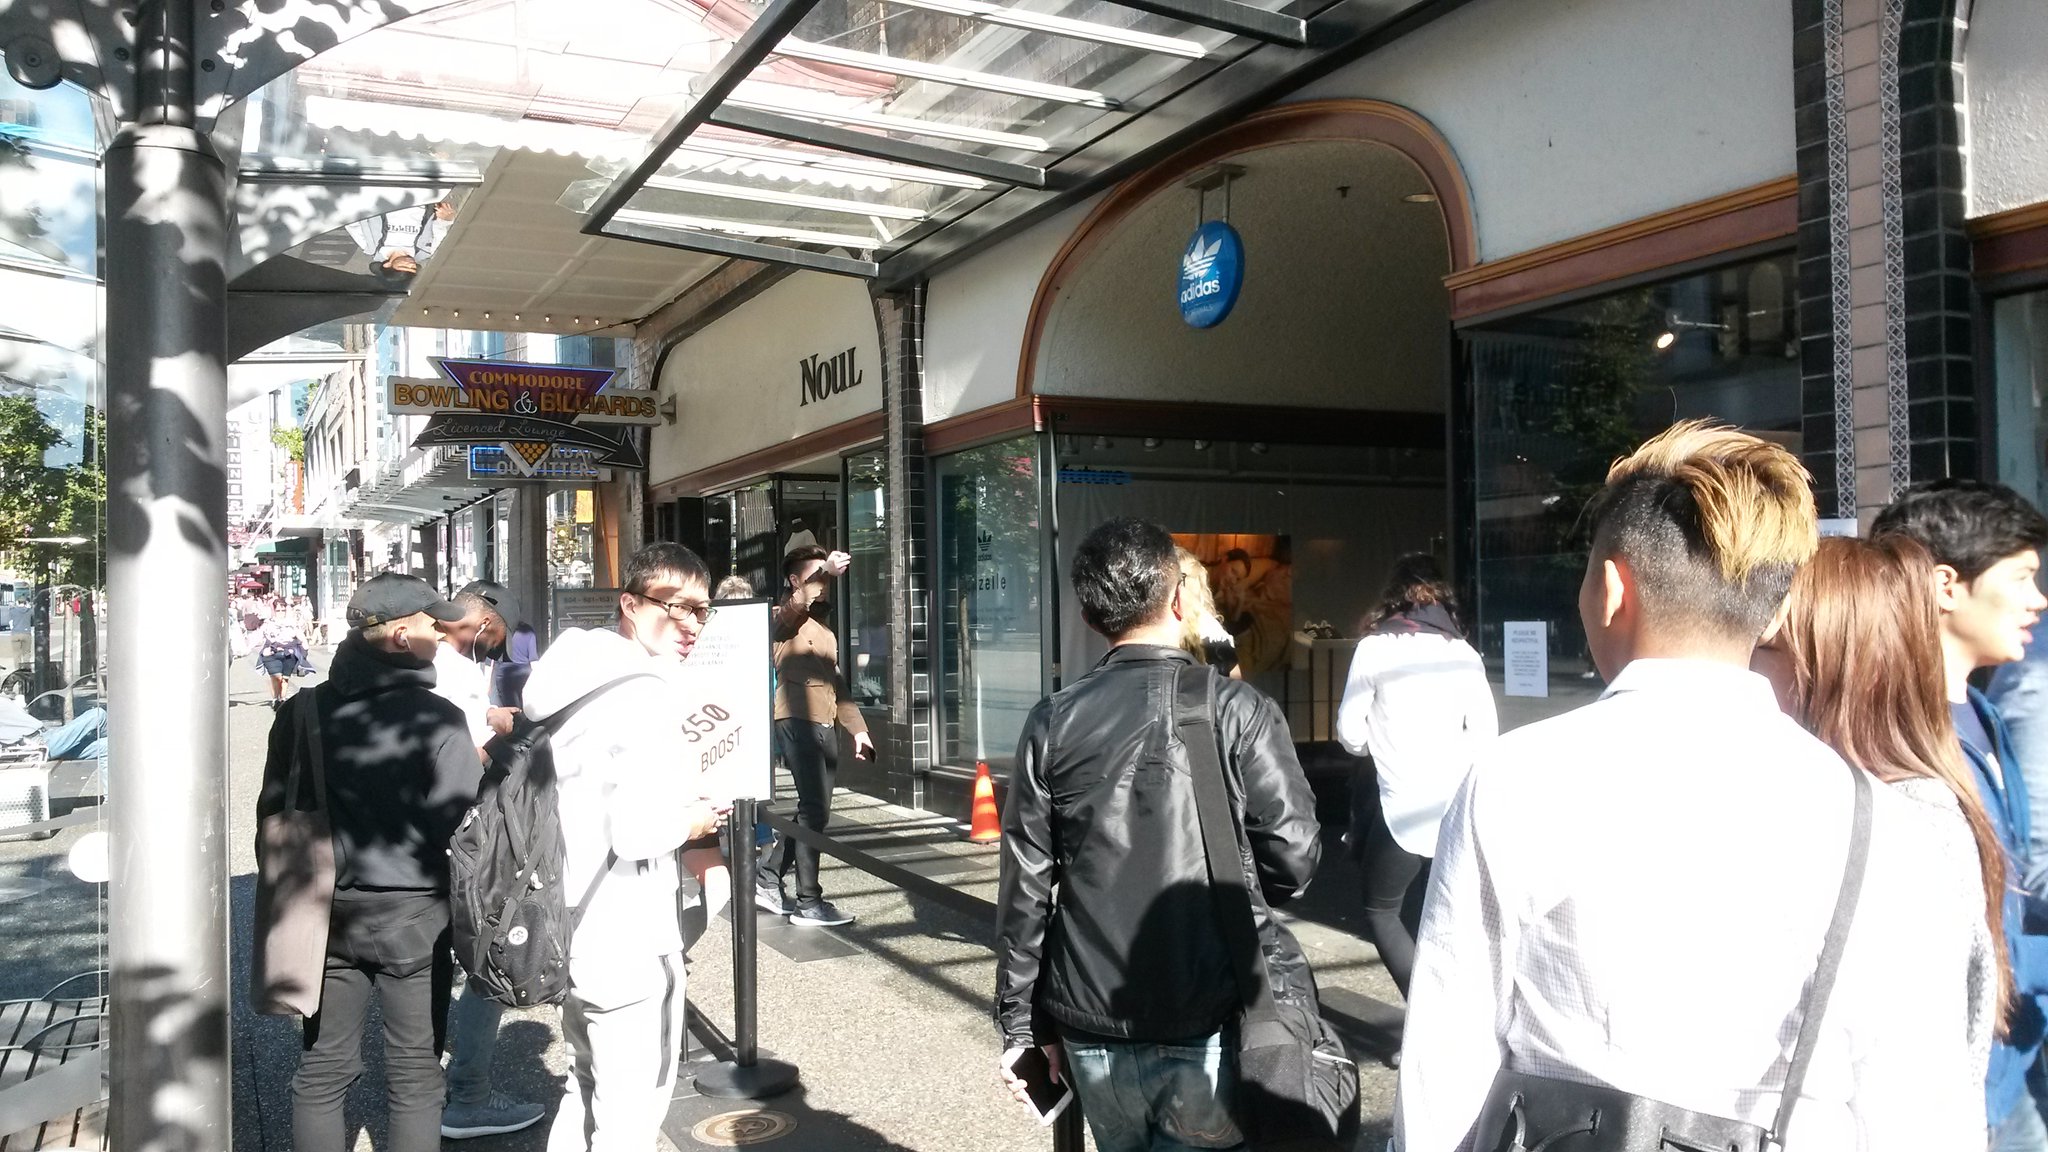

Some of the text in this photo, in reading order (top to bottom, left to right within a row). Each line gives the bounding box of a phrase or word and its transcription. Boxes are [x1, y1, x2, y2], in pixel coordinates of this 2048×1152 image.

[1181, 279, 1221, 304] adidas
[469, 370, 586, 391] COMMODORE
[394, 383, 657, 418] BOWLING & BILLIARDS
[432, 416, 567, 442] Licenced Lounge
[701, 726, 743, 773] BOOST
